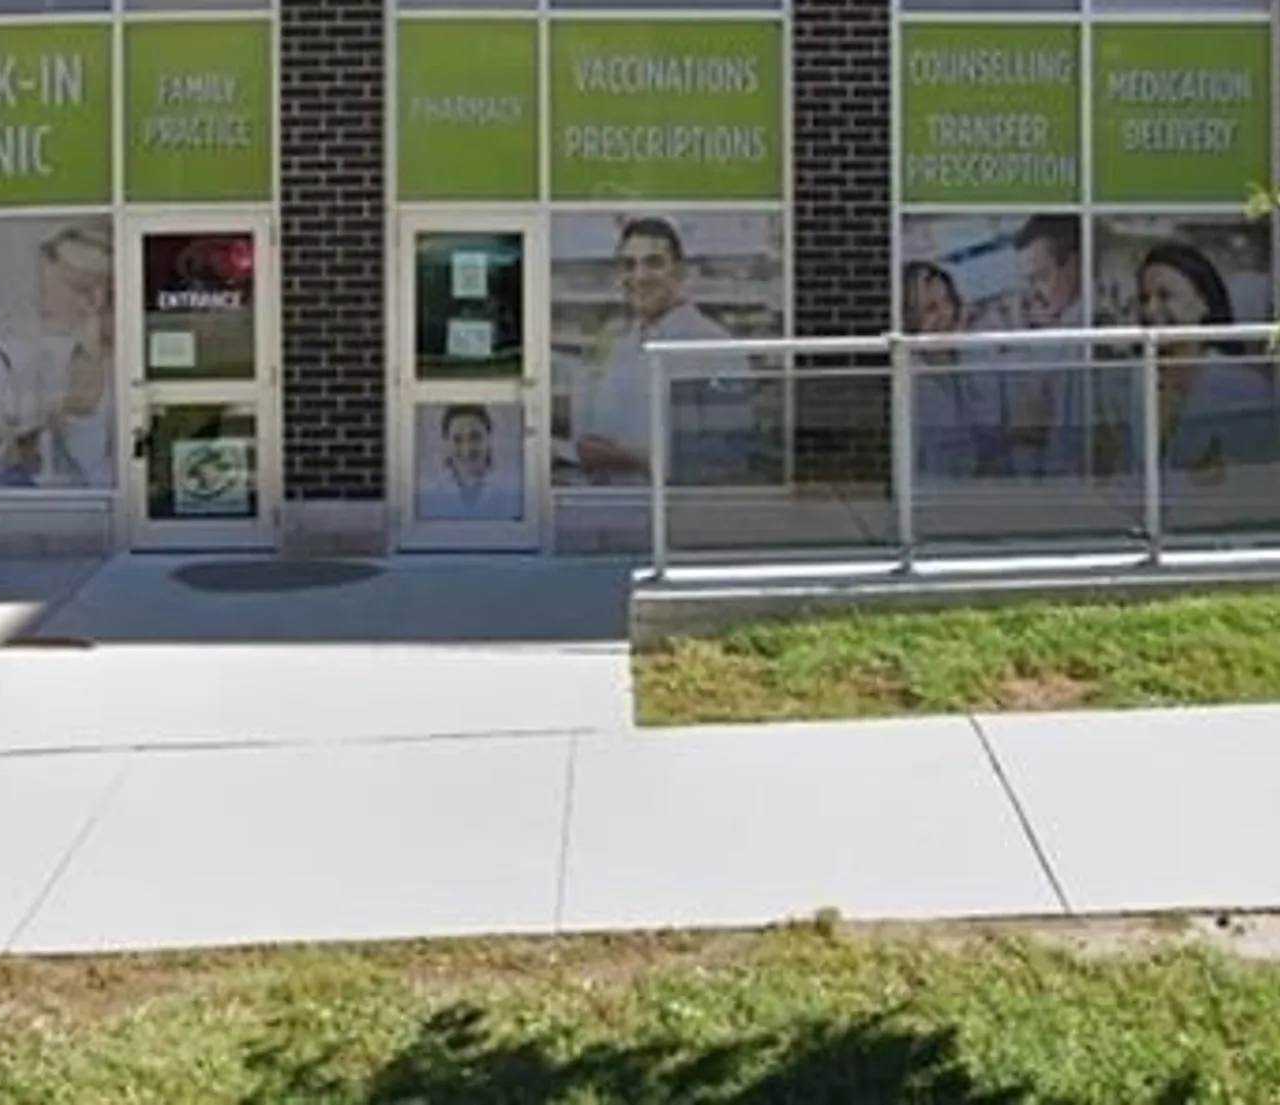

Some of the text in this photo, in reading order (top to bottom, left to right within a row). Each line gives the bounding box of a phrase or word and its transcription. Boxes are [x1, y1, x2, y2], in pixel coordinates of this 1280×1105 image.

[573, 56, 759, 94] VACCINATIONS
[910, 50, 1074, 85] COUNSELLING
[159, 74, 237, 103] FAMILY
[1109, 69, 1251, 103] MEDICATION
[409, 96, 522, 124] PHARMACY
[148, 117, 250, 148] PRACTICE
[566, 126, 766, 162] PRESCRIPTIONS
[928, 113, 1050, 149] TRANSFER
[1125, 119, 1236, 150] DELIVERY
[907, 154, 1076, 187] PRESCRIPTION
[158, 290, 241, 309] ENTRANCE
